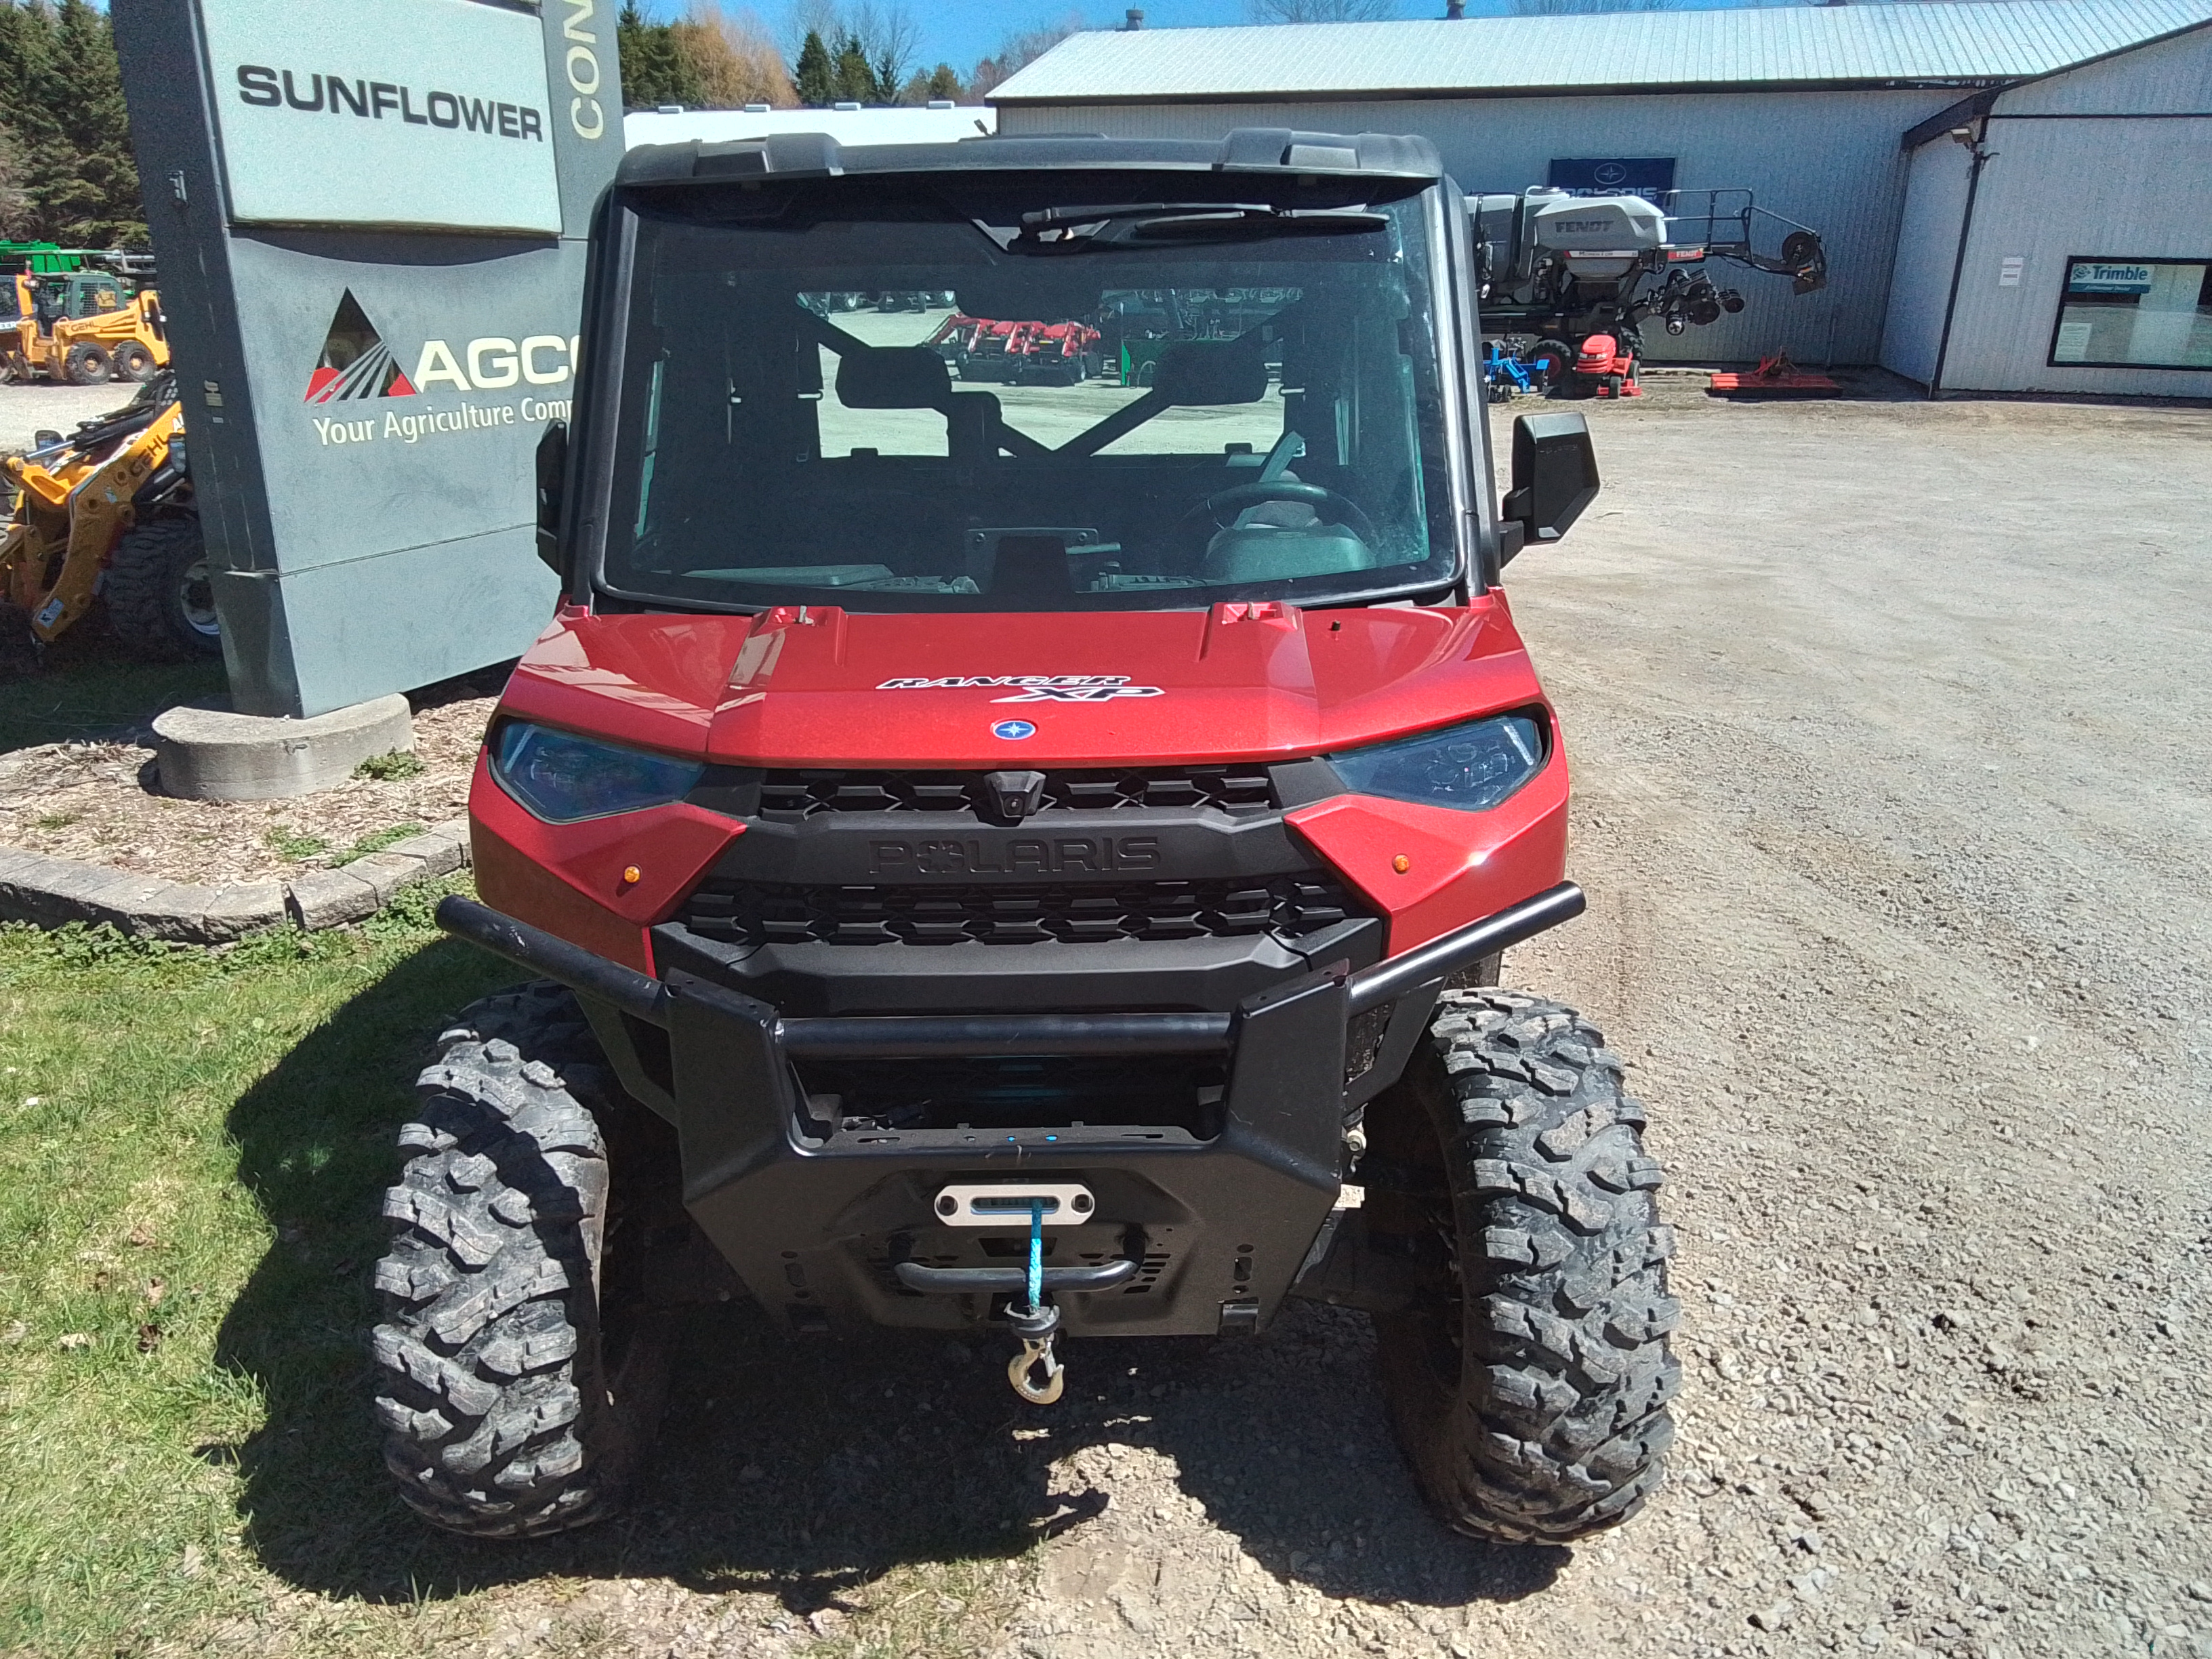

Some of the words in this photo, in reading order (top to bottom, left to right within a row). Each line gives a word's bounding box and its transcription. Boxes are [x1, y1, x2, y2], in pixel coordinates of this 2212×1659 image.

[238, 64, 544, 143] SUNFLOWER
[1555, 220, 1614, 233] FENDT
[2093, 265, 2148, 281] Trimble
[71, 321, 99, 332] GEHL
[413, 335, 581, 394] AGC
[312, 417, 375, 446] Your
[384, 401, 514, 444] Agriculture
[875, 676, 1131, 689] RANGER
[989, 687, 1166, 703] XP
[868, 836, 1161, 874] POLARIS
